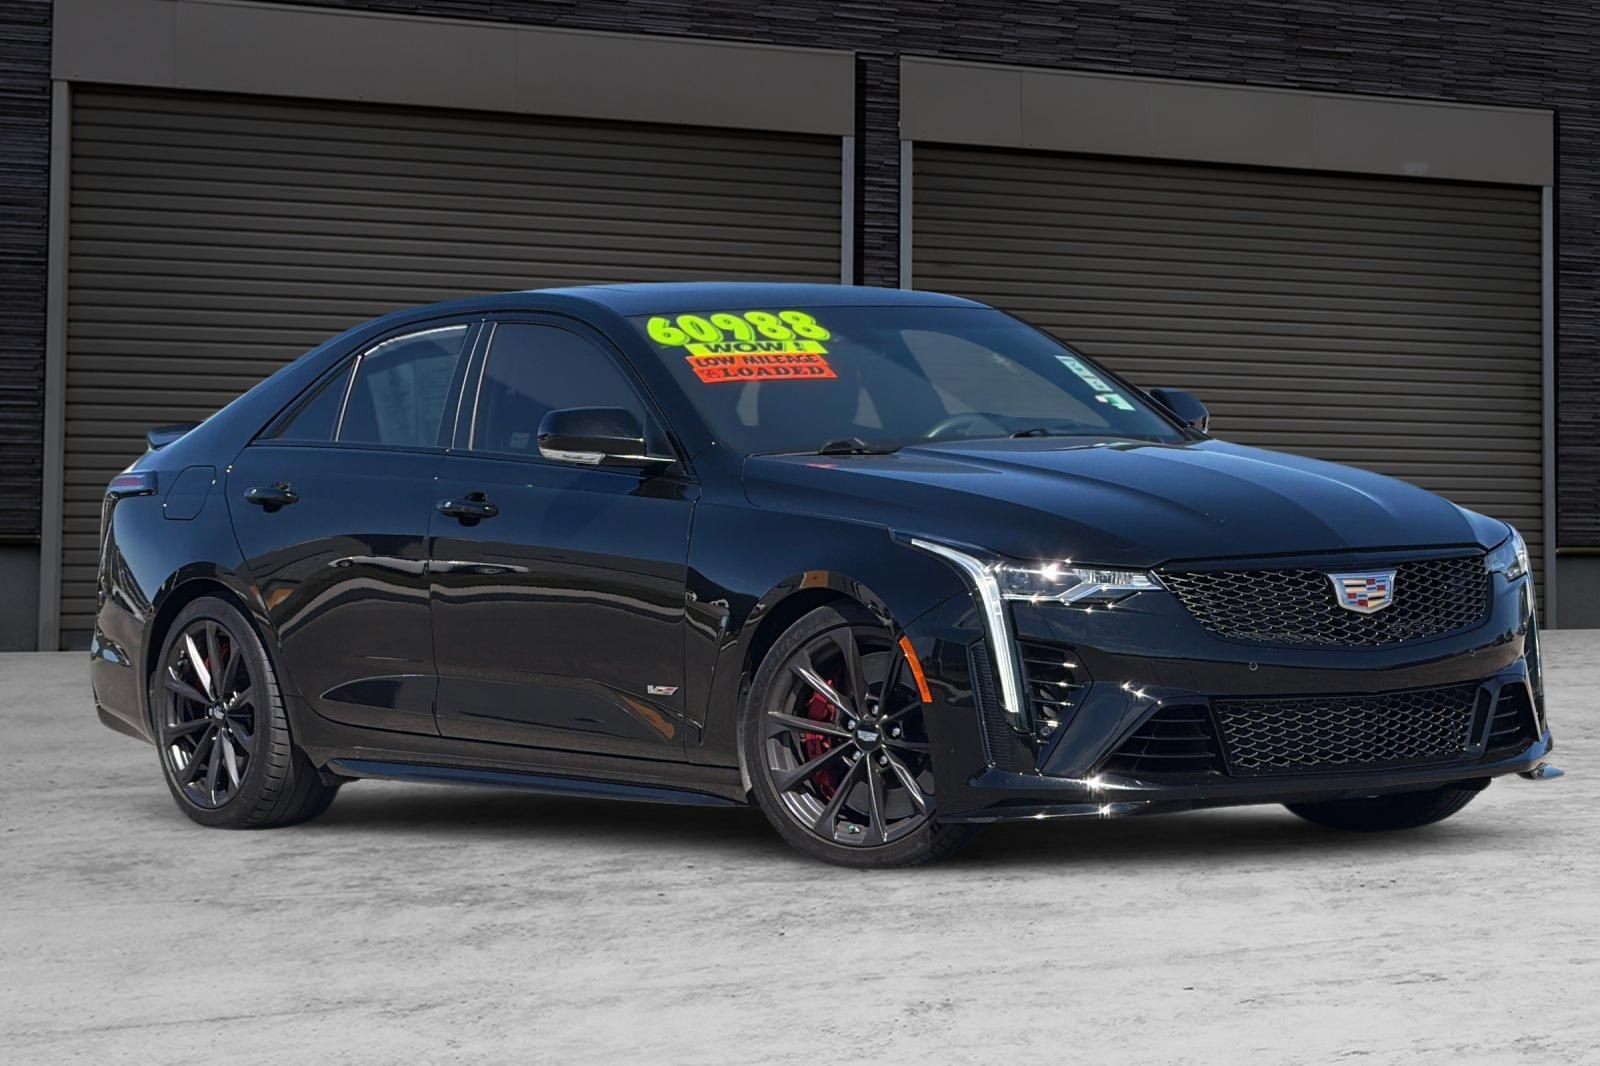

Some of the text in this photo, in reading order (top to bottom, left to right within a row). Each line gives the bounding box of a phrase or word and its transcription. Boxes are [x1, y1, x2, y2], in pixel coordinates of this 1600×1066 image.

[646, 310, 831, 346] 60988
[703, 342, 784, 353] WOW
[695, 354, 819, 367] LOW MILEAGE
[721, 366, 826, 378] LOADED
